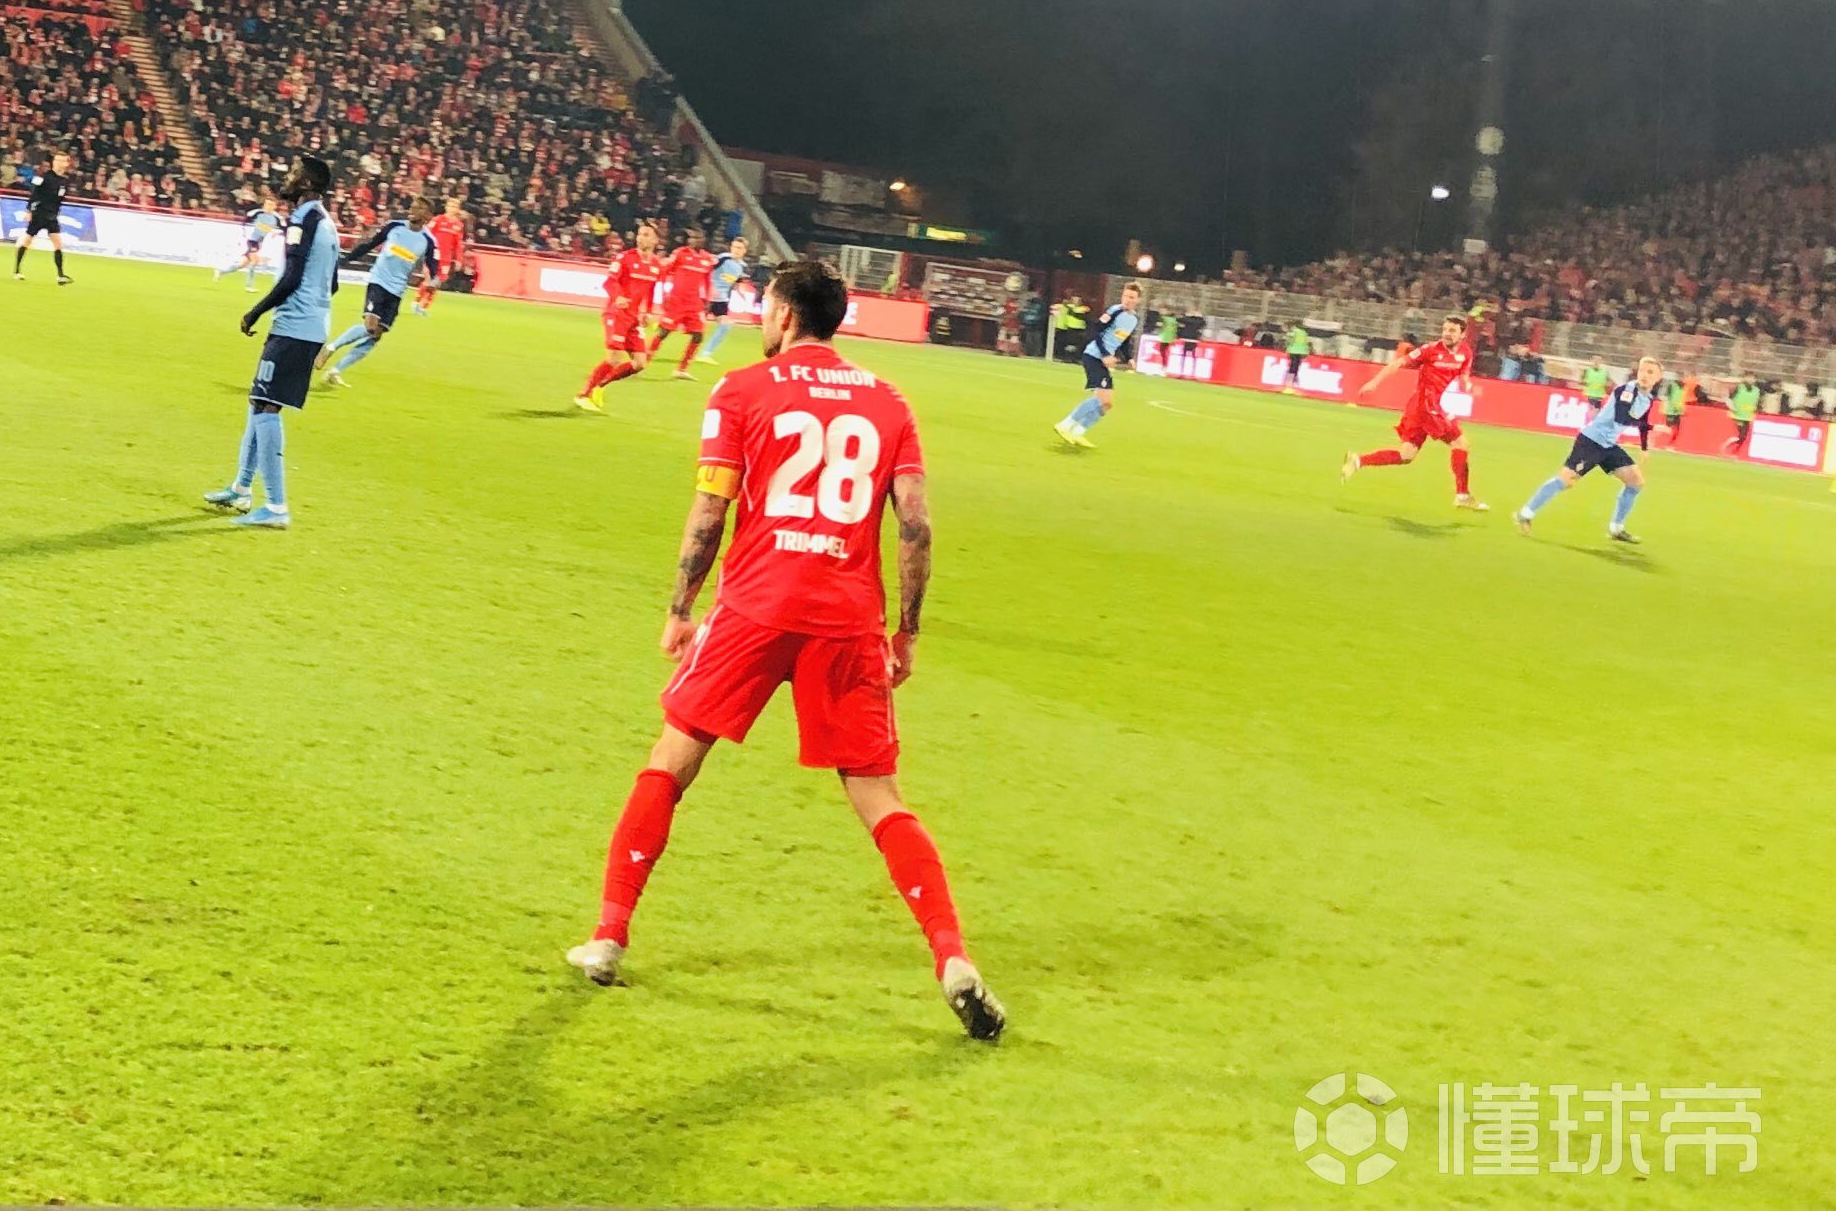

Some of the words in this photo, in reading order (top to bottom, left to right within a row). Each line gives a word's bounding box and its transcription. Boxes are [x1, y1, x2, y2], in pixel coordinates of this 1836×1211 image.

[790, 365, 813, 382] FC
[817, 367, 876, 388] UNION
[808, 386, 852, 401] BERLIN
[764, 410, 881, 525] 28
[773, 529, 849, 560] TRIMMEL
